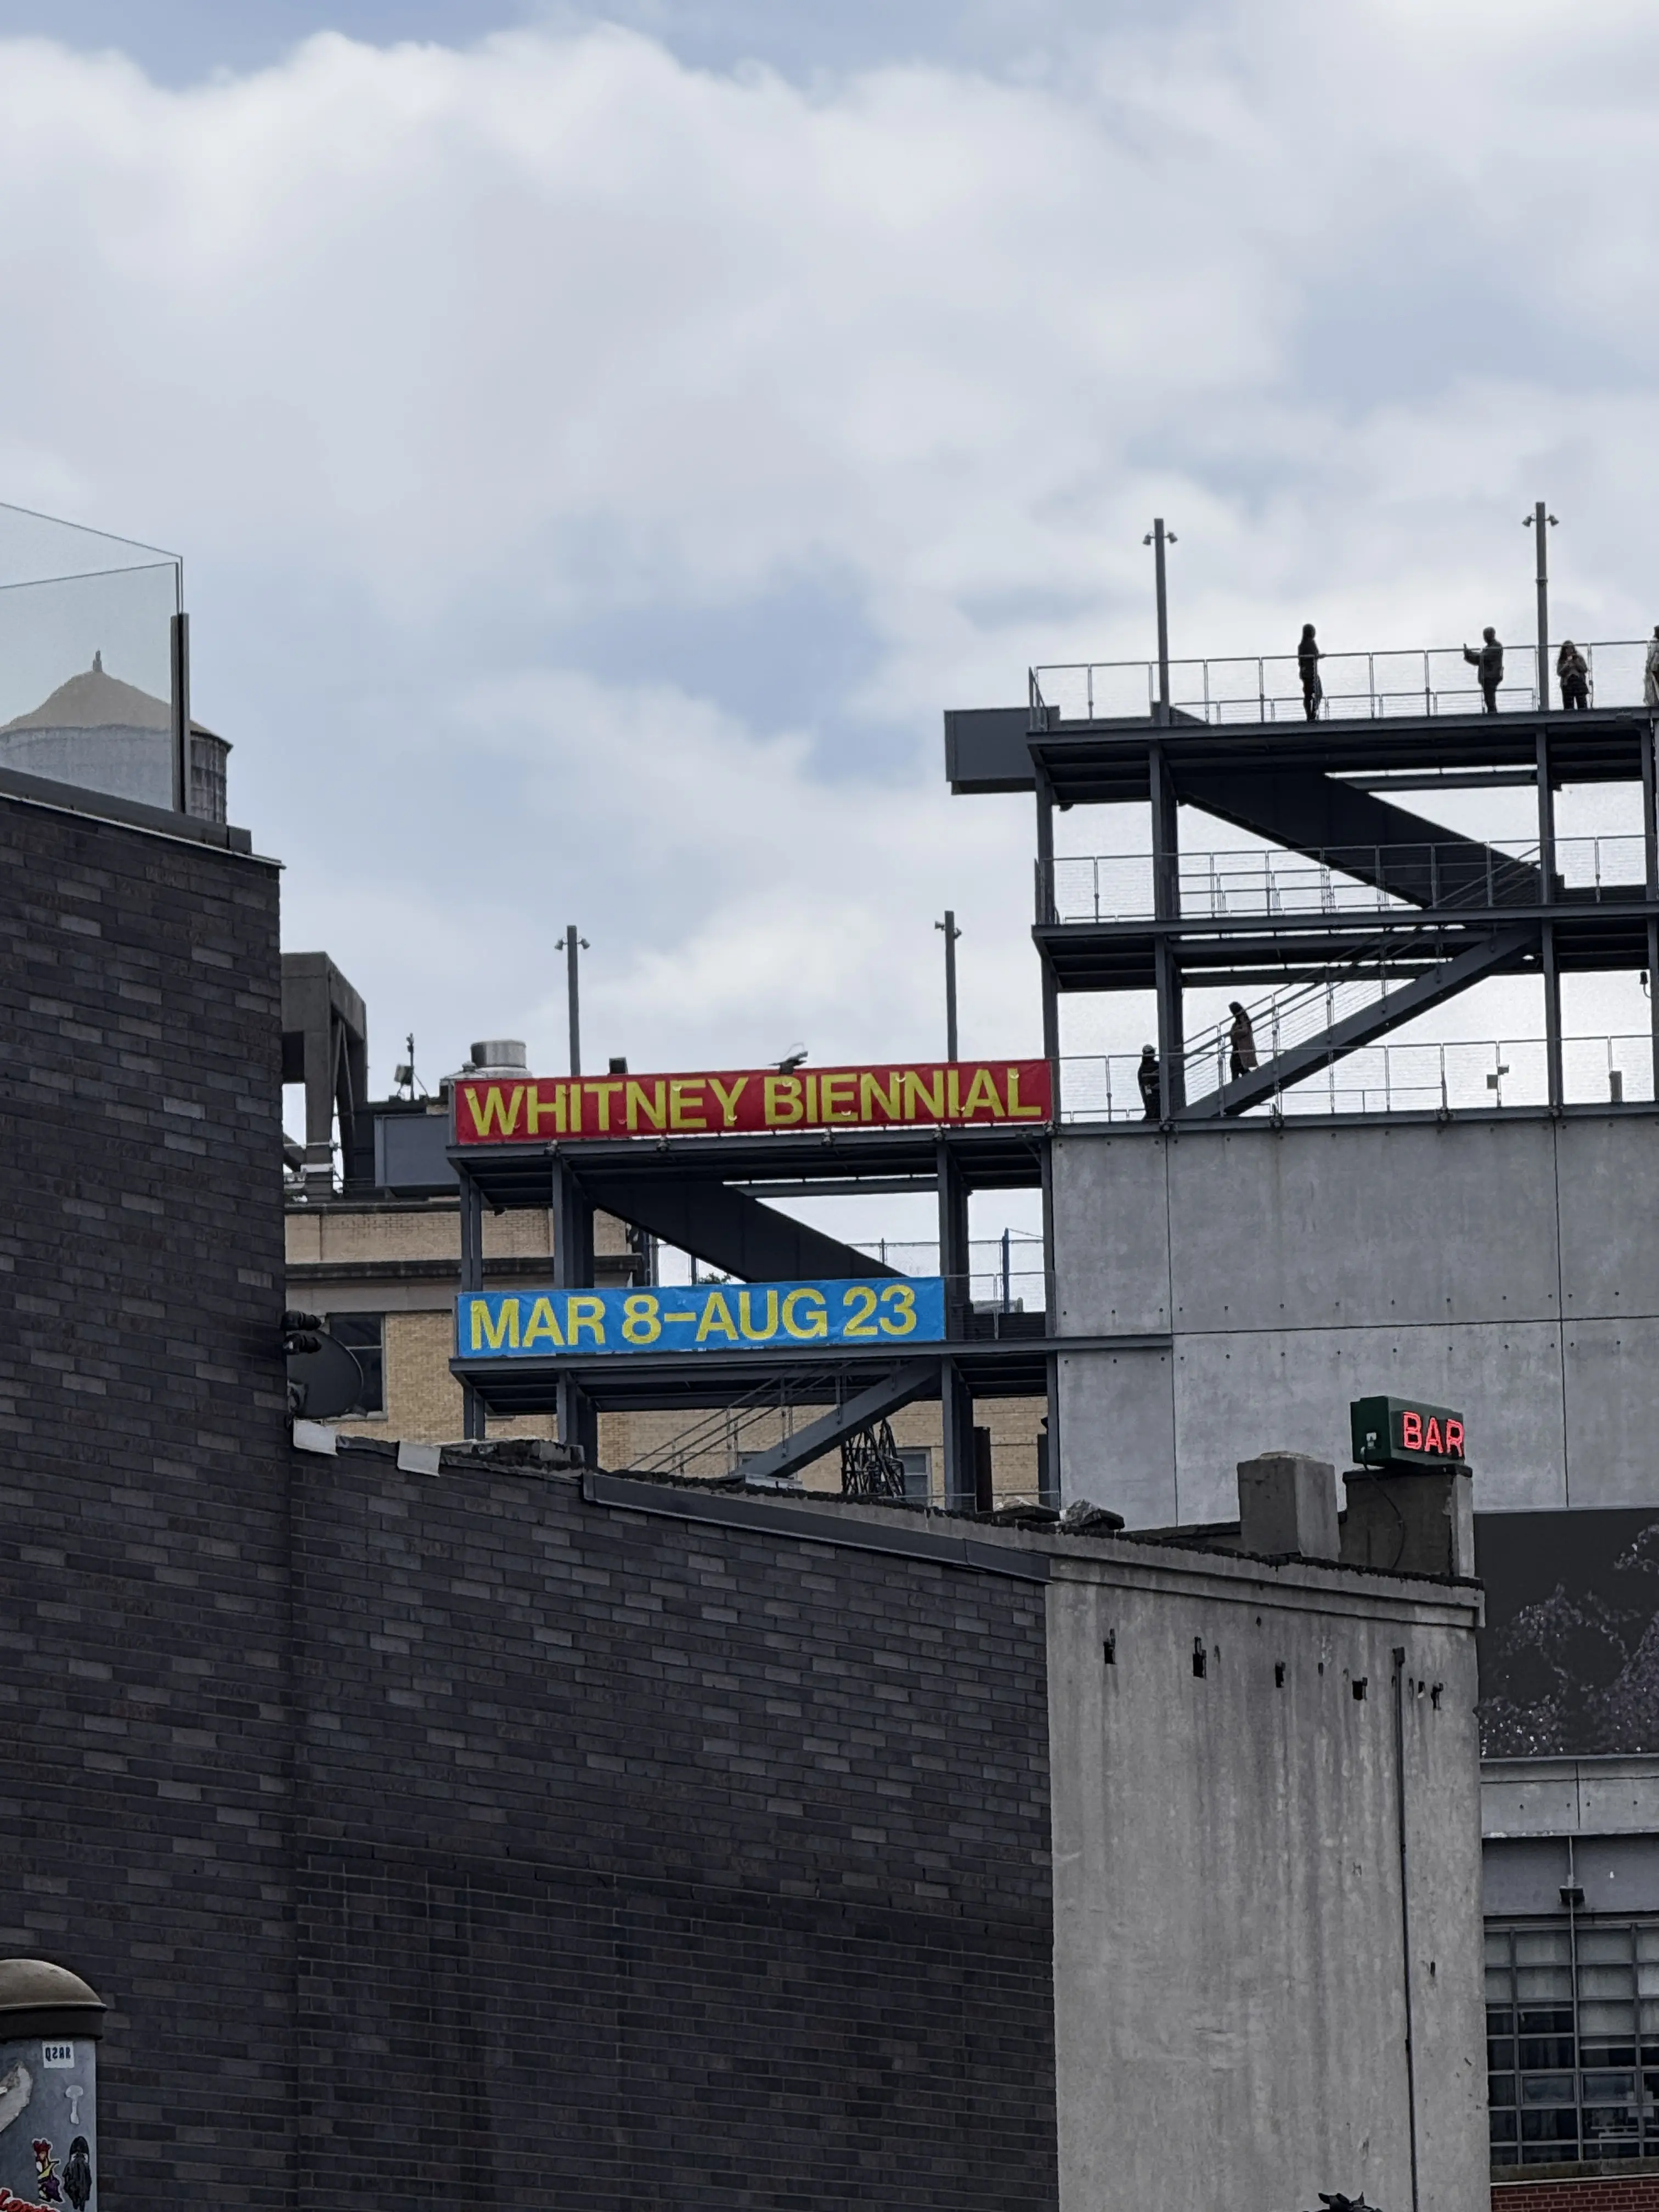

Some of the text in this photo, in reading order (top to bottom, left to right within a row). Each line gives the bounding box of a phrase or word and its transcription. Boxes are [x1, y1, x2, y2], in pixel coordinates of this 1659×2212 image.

[464, 1068, 1043, 1136] WHITNEY BIENNIAL
[470, 1296, 605, 1349] MAR
[843, 1285, 917, 1336] 23
[1402, 1412, 1464, 1457] BAR
